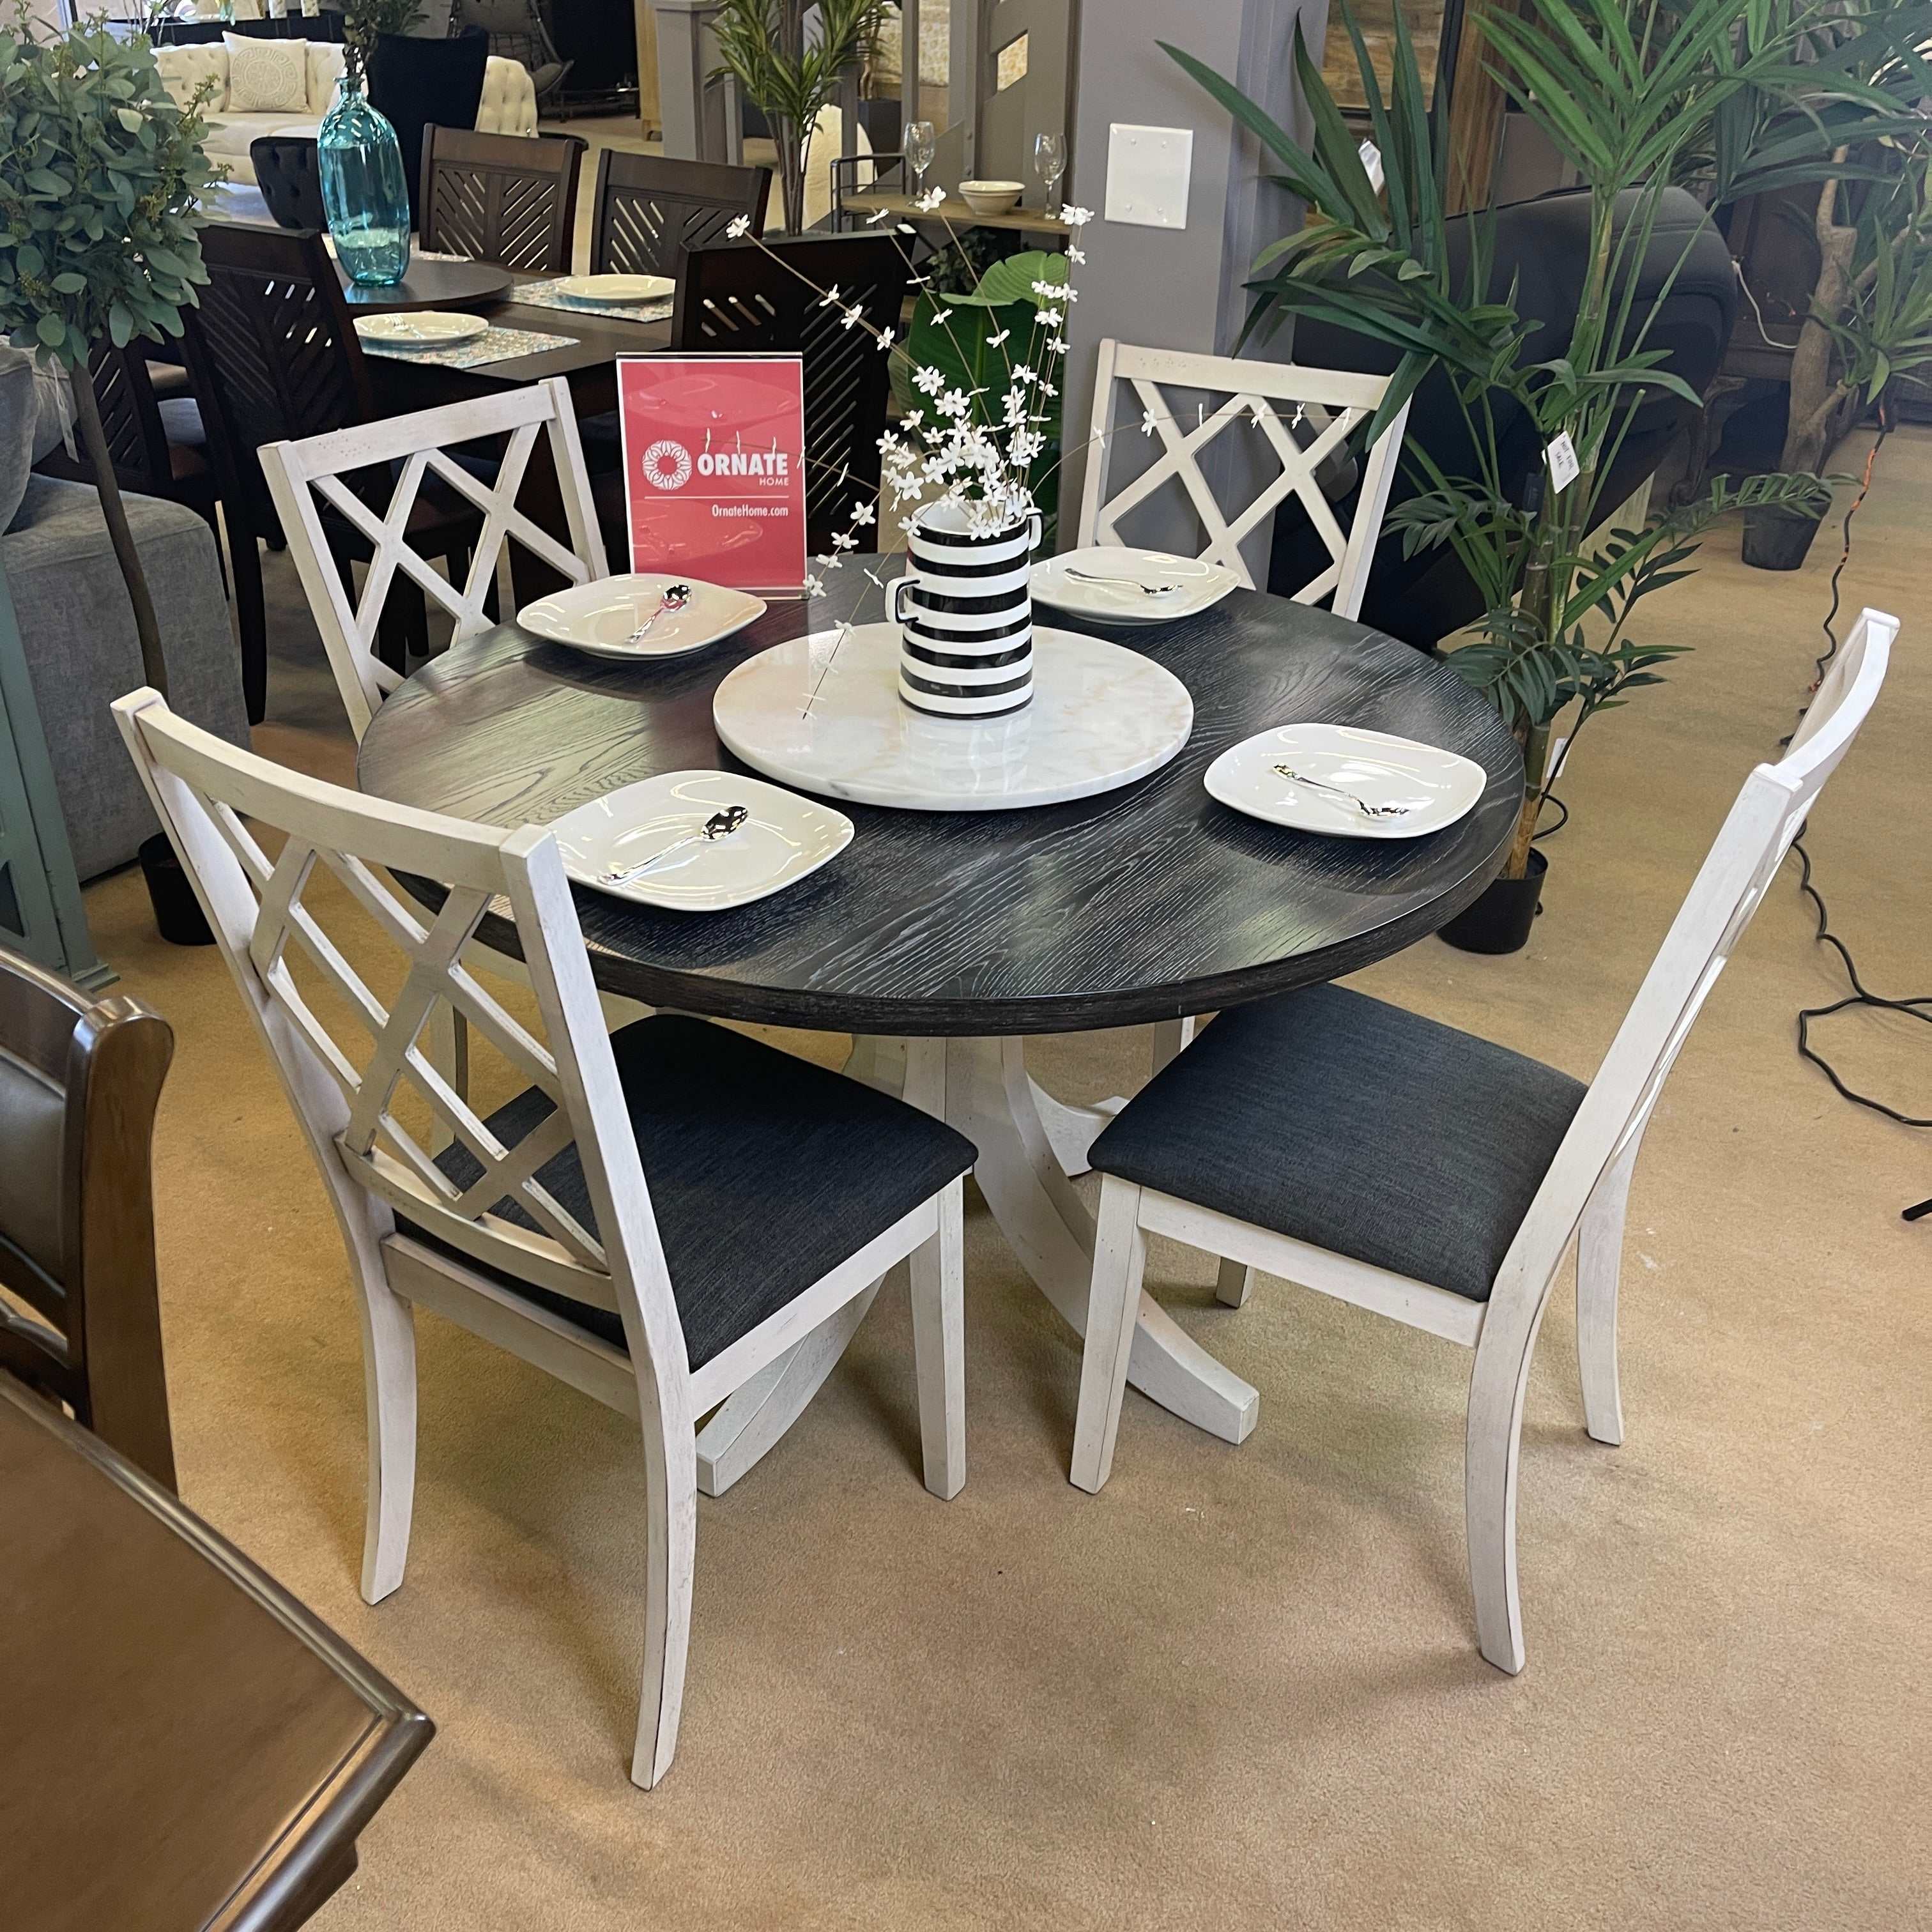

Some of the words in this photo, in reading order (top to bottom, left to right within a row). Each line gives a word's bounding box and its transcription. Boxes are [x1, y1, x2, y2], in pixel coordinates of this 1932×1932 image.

[697, 453, 788, 476] ORNATE
[758, 477, 789, 486] HOME
[712, 504, 788, 517] OrnateHome.com
